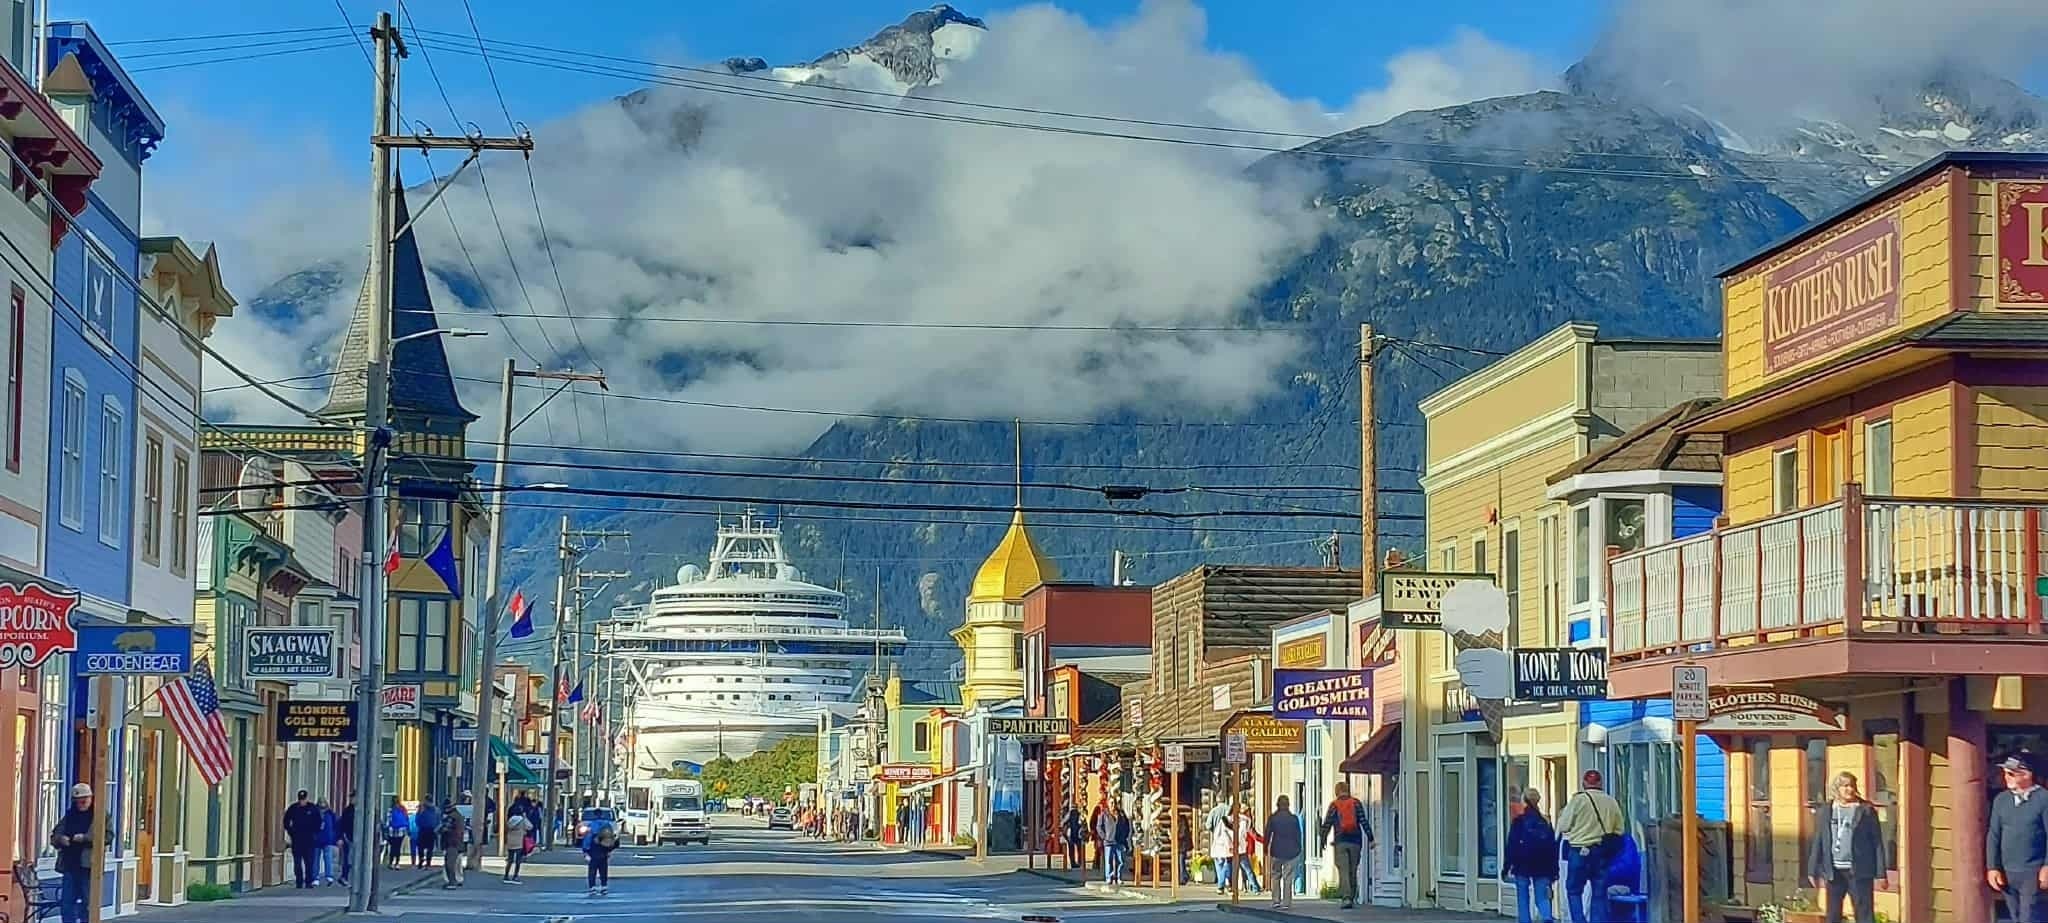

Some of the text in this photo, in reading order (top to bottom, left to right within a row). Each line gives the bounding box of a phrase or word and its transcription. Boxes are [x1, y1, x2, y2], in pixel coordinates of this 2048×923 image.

[1767, 233, 1895, 344] KLOTHES RUSH
[250, 635, 331, 658] SKAGWAY
[268, 655, 313, 664] TOURS
[1518, 652, 1560, 681] KONE
[1684, 671, 1696, 681] 20
[1283, 675, 1362, 697] CREATIVE
[1533, 685, 1544, 697] ICE
[1577, 685, 1597, 696] CANDY
[1278, 687, 1370, 712] GOLDSMITH
[1707, 692, 1777, 710] KLOTHES
[1780, 693, 1819, 710] RUSH
[289, 705, 347, 715] KLONDIKE
[1315, 706, 1368, 716] OF ALASKA
[284, 716, 351, 727] GOLD RUSH
[1730, 713, 1797, 721] SOUVENIRS
[1003, 720, 1067, 732] PANTHEON
[295, 727, 341, 737] JEWELS
[1251, 727, 1300, 737] GALLERY
